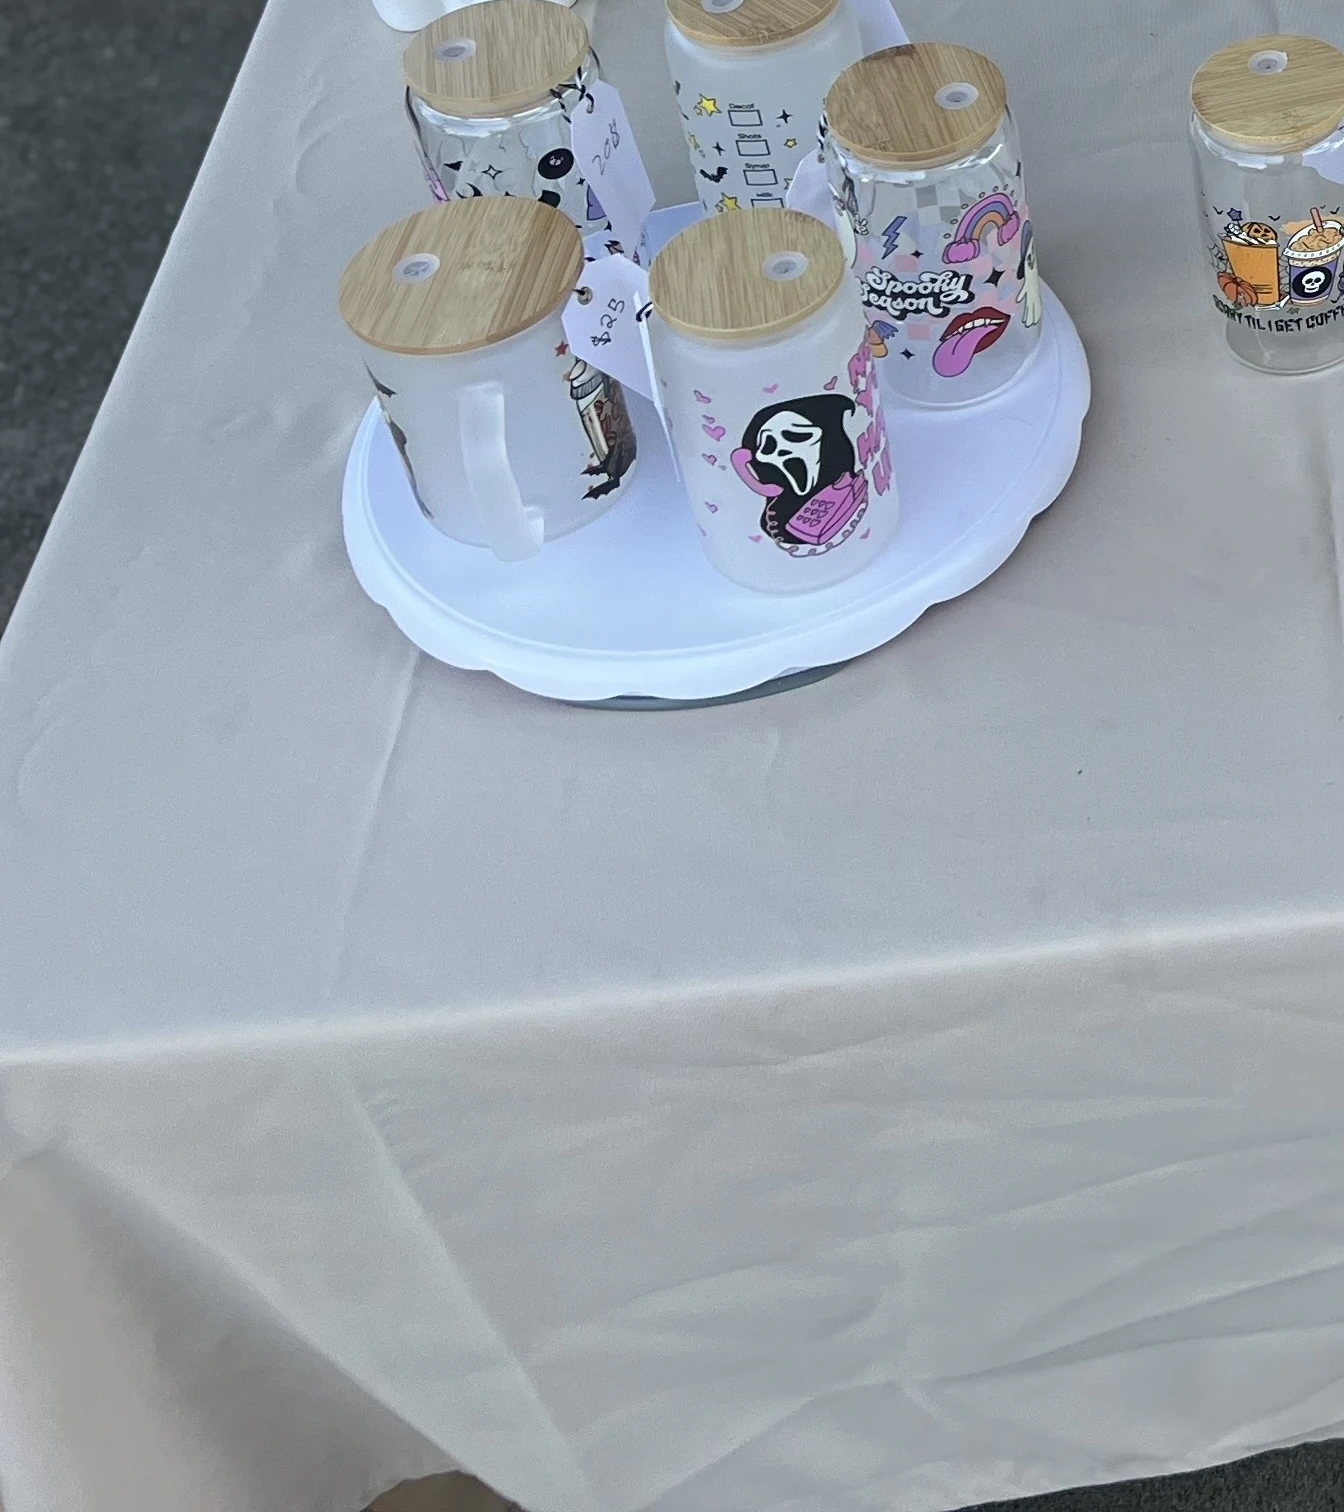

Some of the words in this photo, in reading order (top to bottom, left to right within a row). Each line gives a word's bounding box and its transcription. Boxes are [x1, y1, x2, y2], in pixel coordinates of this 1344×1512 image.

[856, 276, 949, 320] Season
[865, 265, 974, 303] Spooky
[589, 297, 626, 347] $25
[1244, 315, 1266, 331] TIL
[1274, 317, 1304, 333] GET
